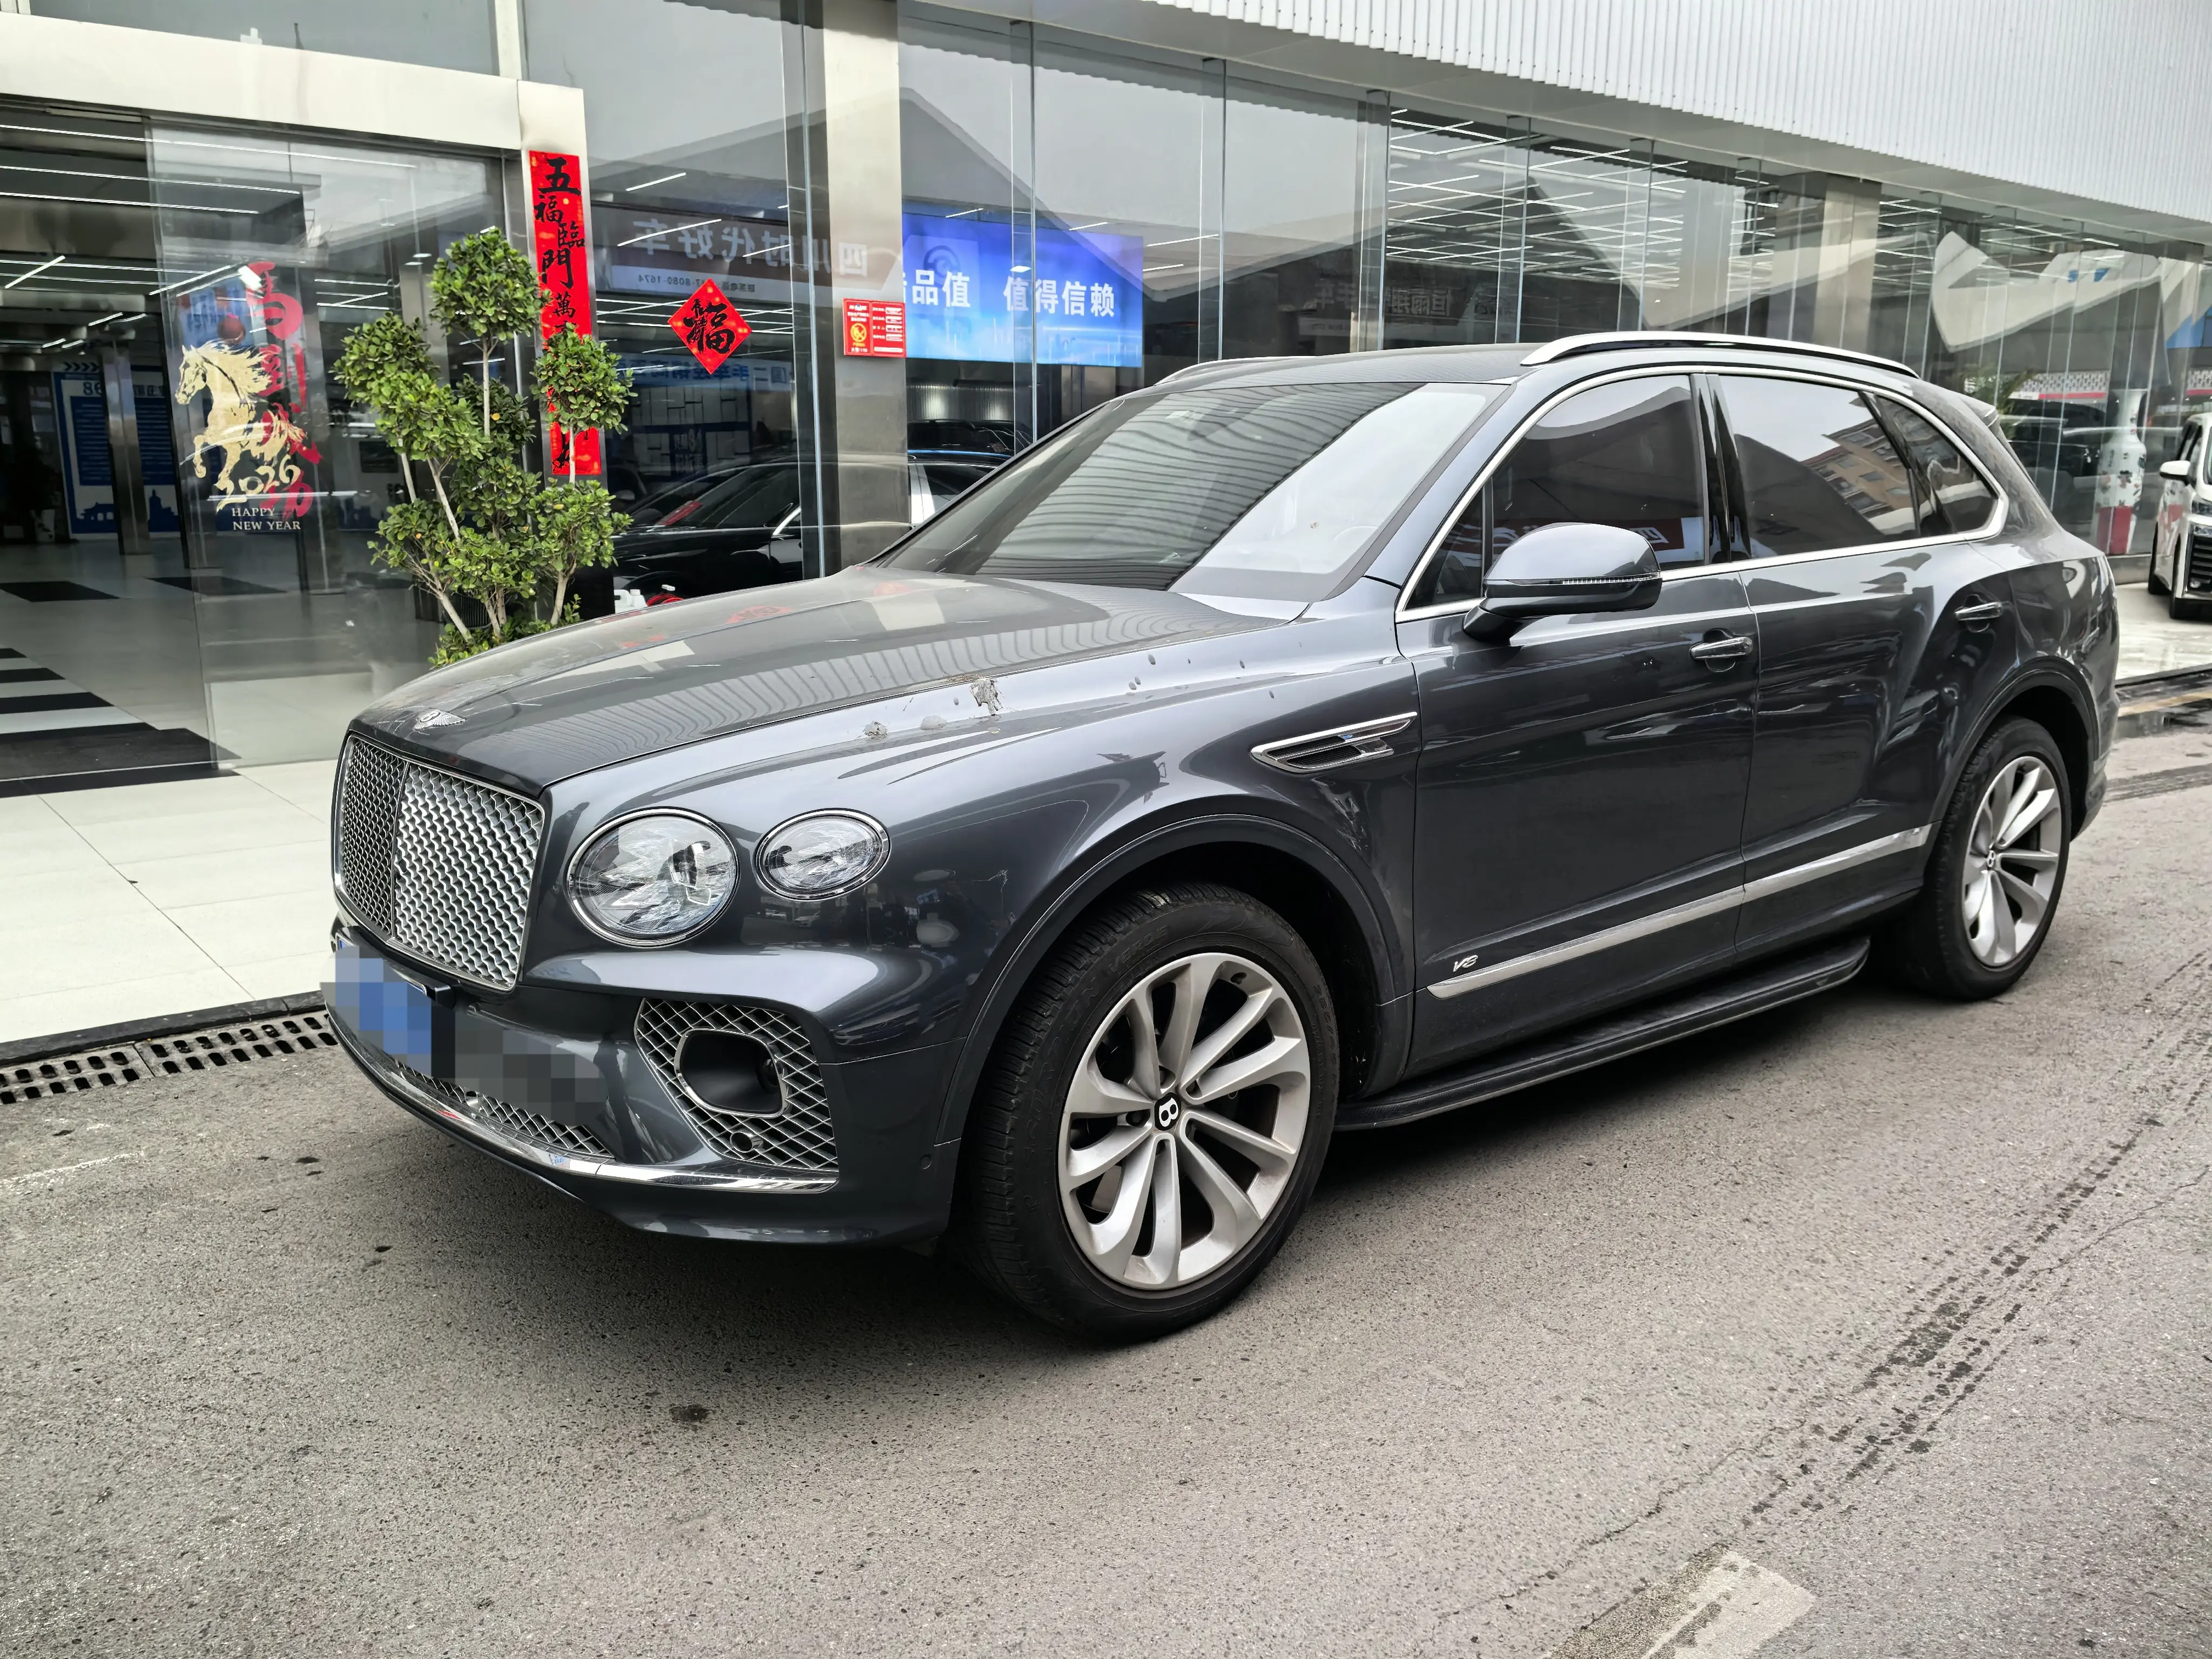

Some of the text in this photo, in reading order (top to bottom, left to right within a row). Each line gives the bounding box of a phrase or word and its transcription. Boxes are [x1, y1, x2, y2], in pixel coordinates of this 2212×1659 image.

[903, 269, 1115, 317] 品值 值得信赖
[683, 299, 736, 354] 福
[214, 454, 301, 513] 2026
[232, 508, 275, 517] HAPPY
[233, 521, 301, 530] NEW YEAR
